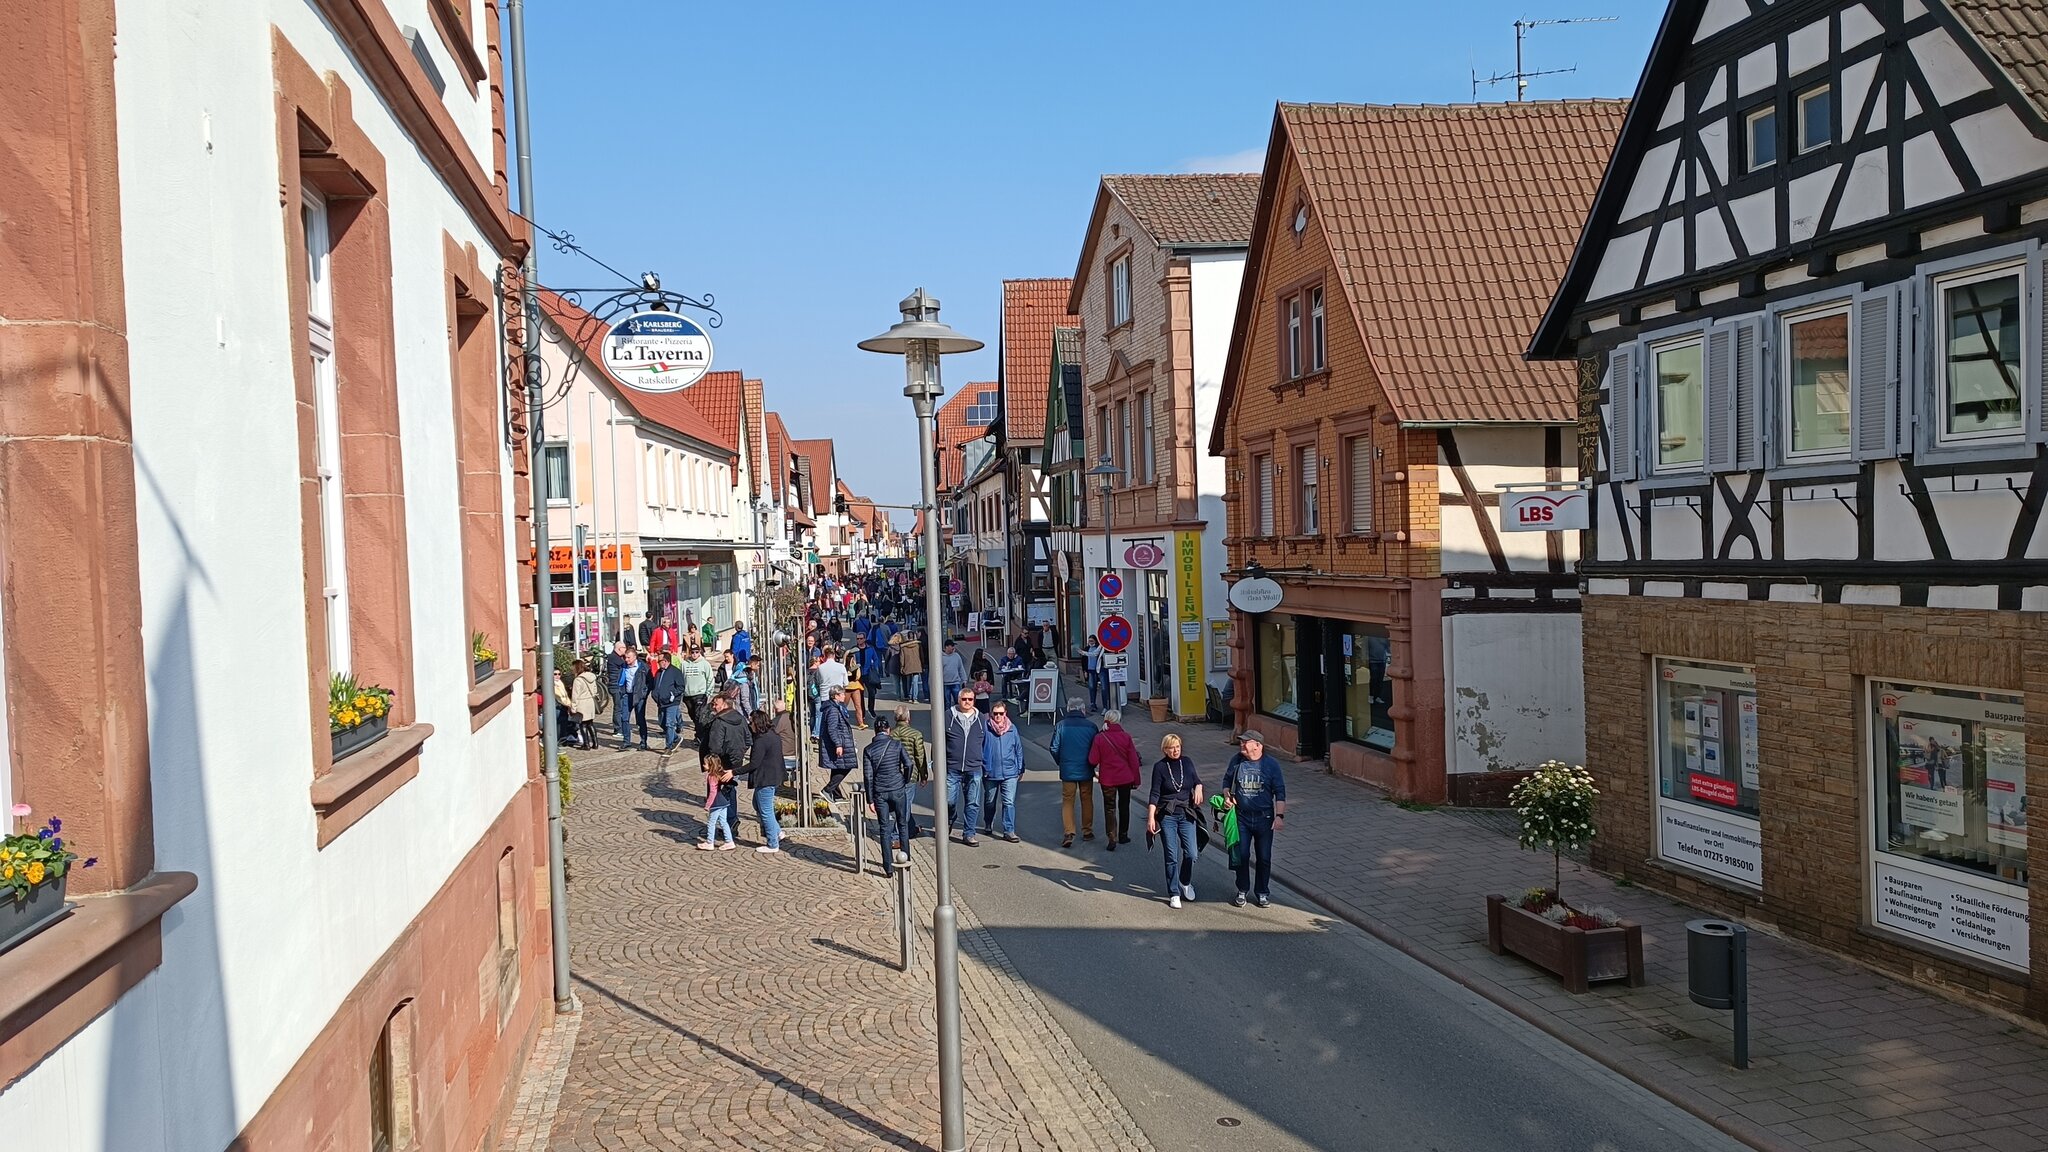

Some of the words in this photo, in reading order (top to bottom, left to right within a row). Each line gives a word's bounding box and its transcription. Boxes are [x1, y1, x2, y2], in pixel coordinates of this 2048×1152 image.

[621, 337, 659, 345] Ristorante
[665, 337, 693, 345] Pizzeria
[612, 346, 632, 360] La
[635, 346, 703, 360] Taverna
[638, 376, 678, 384] Ratskeller
[1519, 506, 1554, 522] LBS
[1182, 532, 1195, 612] IMMOBILIEN
[1186, 644, 1197, 691] LIEBEL
[1882, 698, 1897, 706] LBS
[1905, 791, 1915, 799] Wir
[1916, 792, 1938, 804] haben's
[1939, 799, 1958, 808] getan!
[1674, 818, 1711, 834] Baufinanzierer
[1711, 828, 1722, 837] und
[1704, 838, 1713, 846] vor
[1713, 840, 1725, 849] Ort!
[1677, 841, 1703, 856] Telefon
[1703, 849, 1724, 863] 07275
[1725, 855, 1754, 872] 9185010
[1888, 876, 1923, 891] Bausparen
[1889, 887, 1943, 909] Baufinanzierung
[1955, 894, 1991, 910] Staatliche
[1889, 897, 1940, 918] Wohneigentum
[1955, 905, 1996, 923] Immobilien
[1889, 908, 1936, 929] Altersvorsorge
[1956, 917, 1996, 935] Geldanlage
[1956, 928, 2011, 951] Versicherungen
